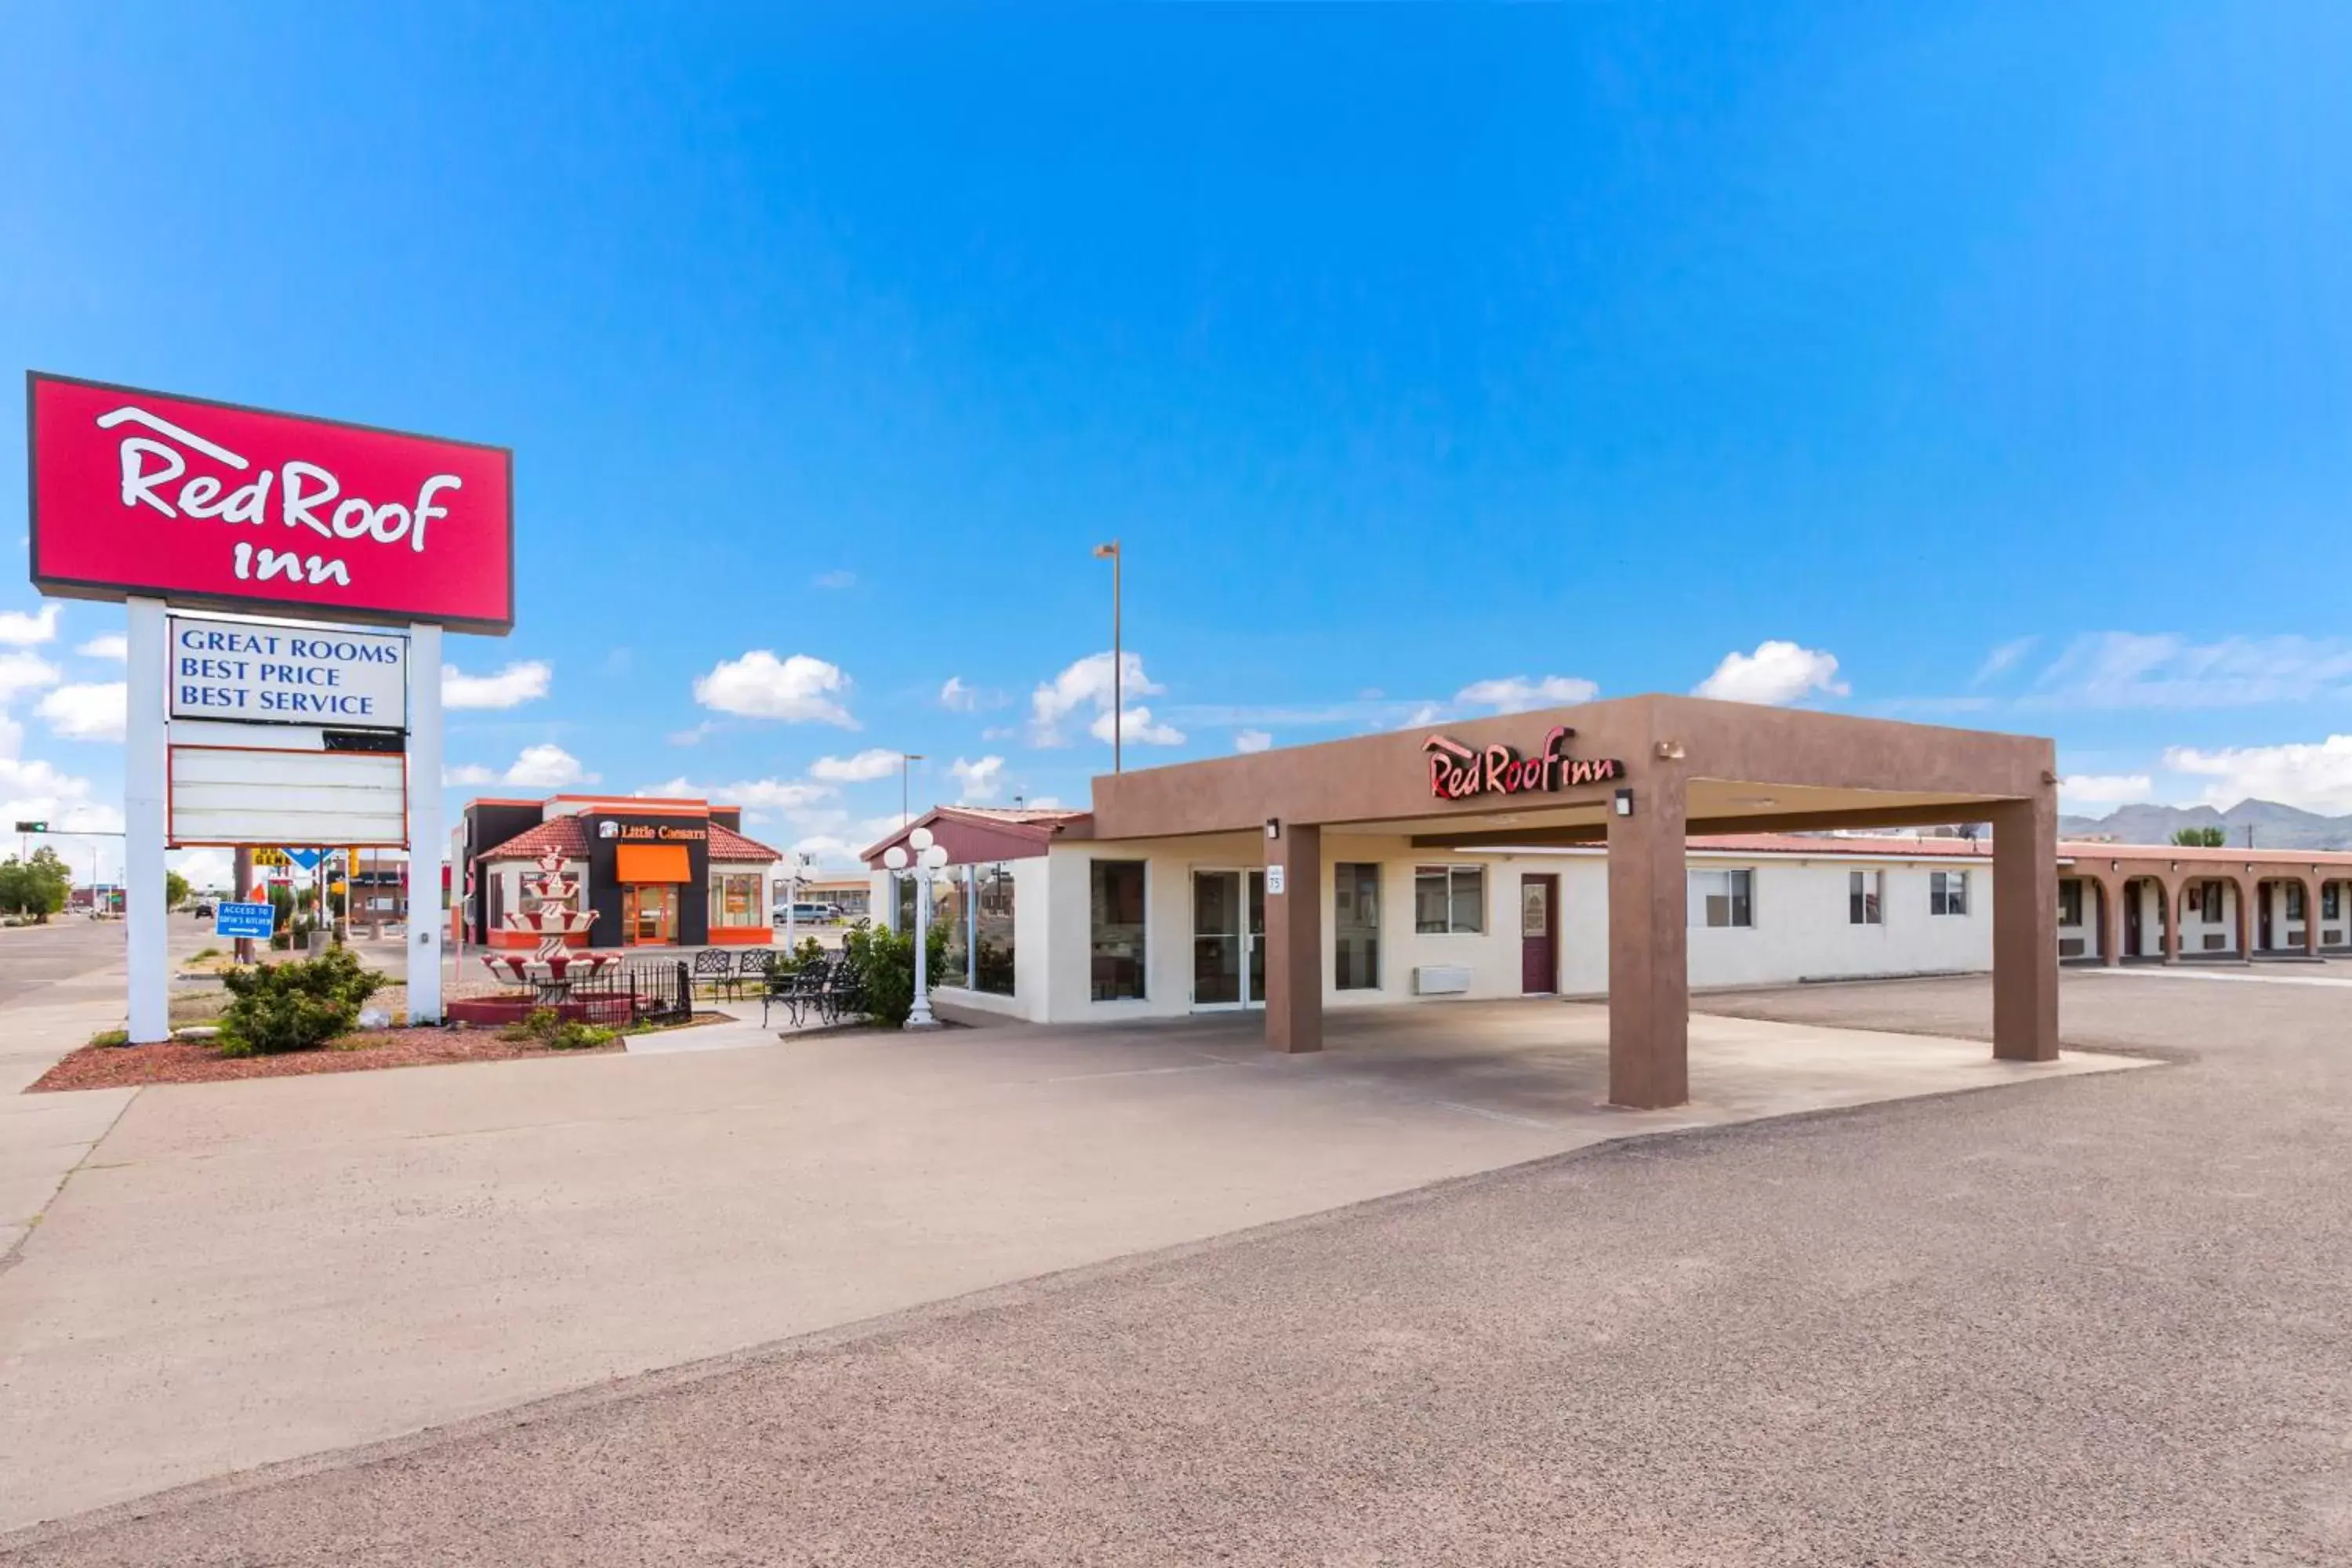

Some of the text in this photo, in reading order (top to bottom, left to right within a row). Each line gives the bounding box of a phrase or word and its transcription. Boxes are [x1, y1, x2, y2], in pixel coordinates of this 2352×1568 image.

[120, 437, 463, 553] Red Roof
[181, 630, 398, 665] GREAT ROOMS
[181, 657, 340, 687] BEST PRICE
[181, 685, 373, 715] BEST SERVICE
[1430, 751, 1481, 800] Red
[1486, 726, 1573, 796] Roof
[621, 825, 706, 840] Little Caesars
[223, 906, 256, 915] ACCESS
